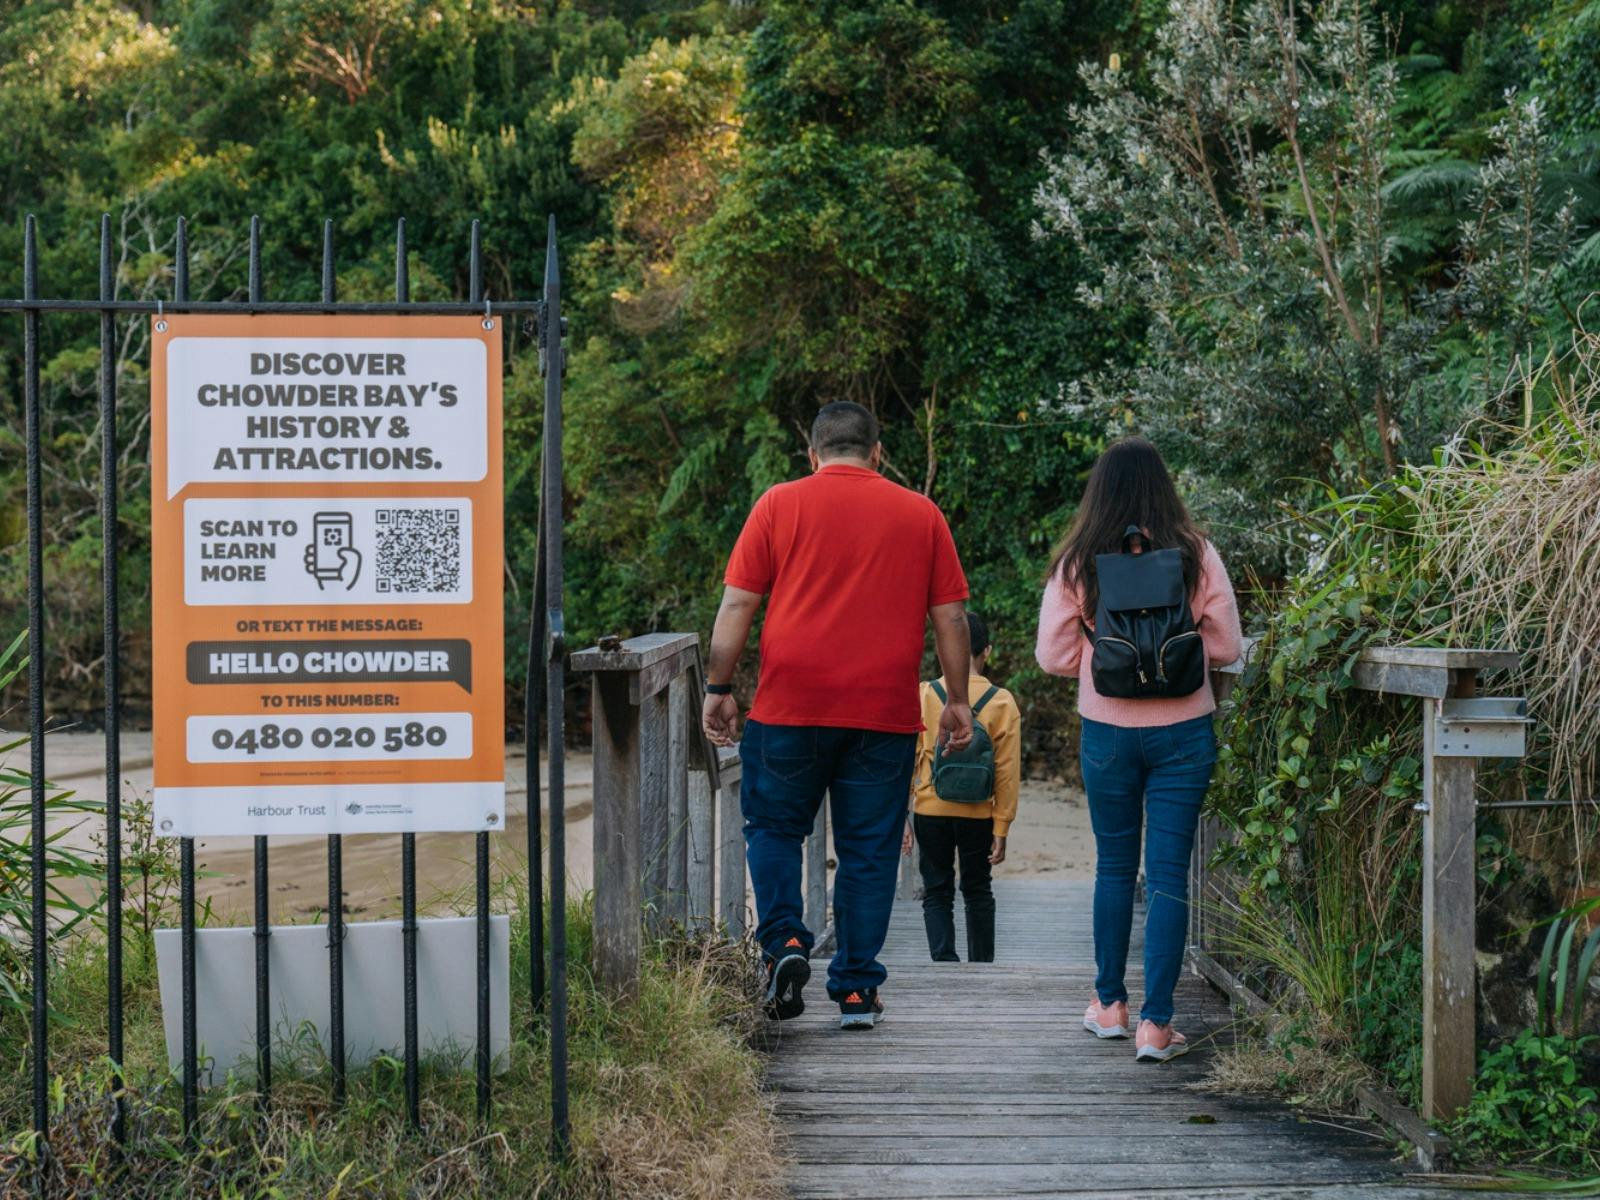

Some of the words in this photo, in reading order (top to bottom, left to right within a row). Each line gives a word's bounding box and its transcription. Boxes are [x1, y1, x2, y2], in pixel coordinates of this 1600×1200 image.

[251, 353, 406, 375] DISCOVER
[198, 384, 358, 407] CHOWDER
[365, 382, 457, 407] BAY'S
[247, 416, 381, 438] HISTORY
[388, 416, 409, 438] &
[214, 447, 442, 470] ATTRACTIONS.
[201, 521, 263, 537] SCAN
[268, 521, 297, 536] TO
[202, 543, 275, 559] LEARN
[202, 566, 265, 581] MORE
[237, 621, 259, 632] OR
[262, 620, 303, 632] TEXT
[307, 620, 338, 631] THE
[341, 619, 422, 631] MESSAGE:
[210, 653, 299, 674] HELLO
[304, 651, 449, 673] CHOWDER
[261, 696, 282, 707] TO
[287, 695, 322, 707] THIS
[326, 694, 399, 706] NUMBER:
[212, 724, 303, 754] 0480
[312, 727, 375, 748] 020
[383, 722, 446, 752] 580
[248, 804, 294, 817] Harbour
[297, 804, 327, 816] Trust
